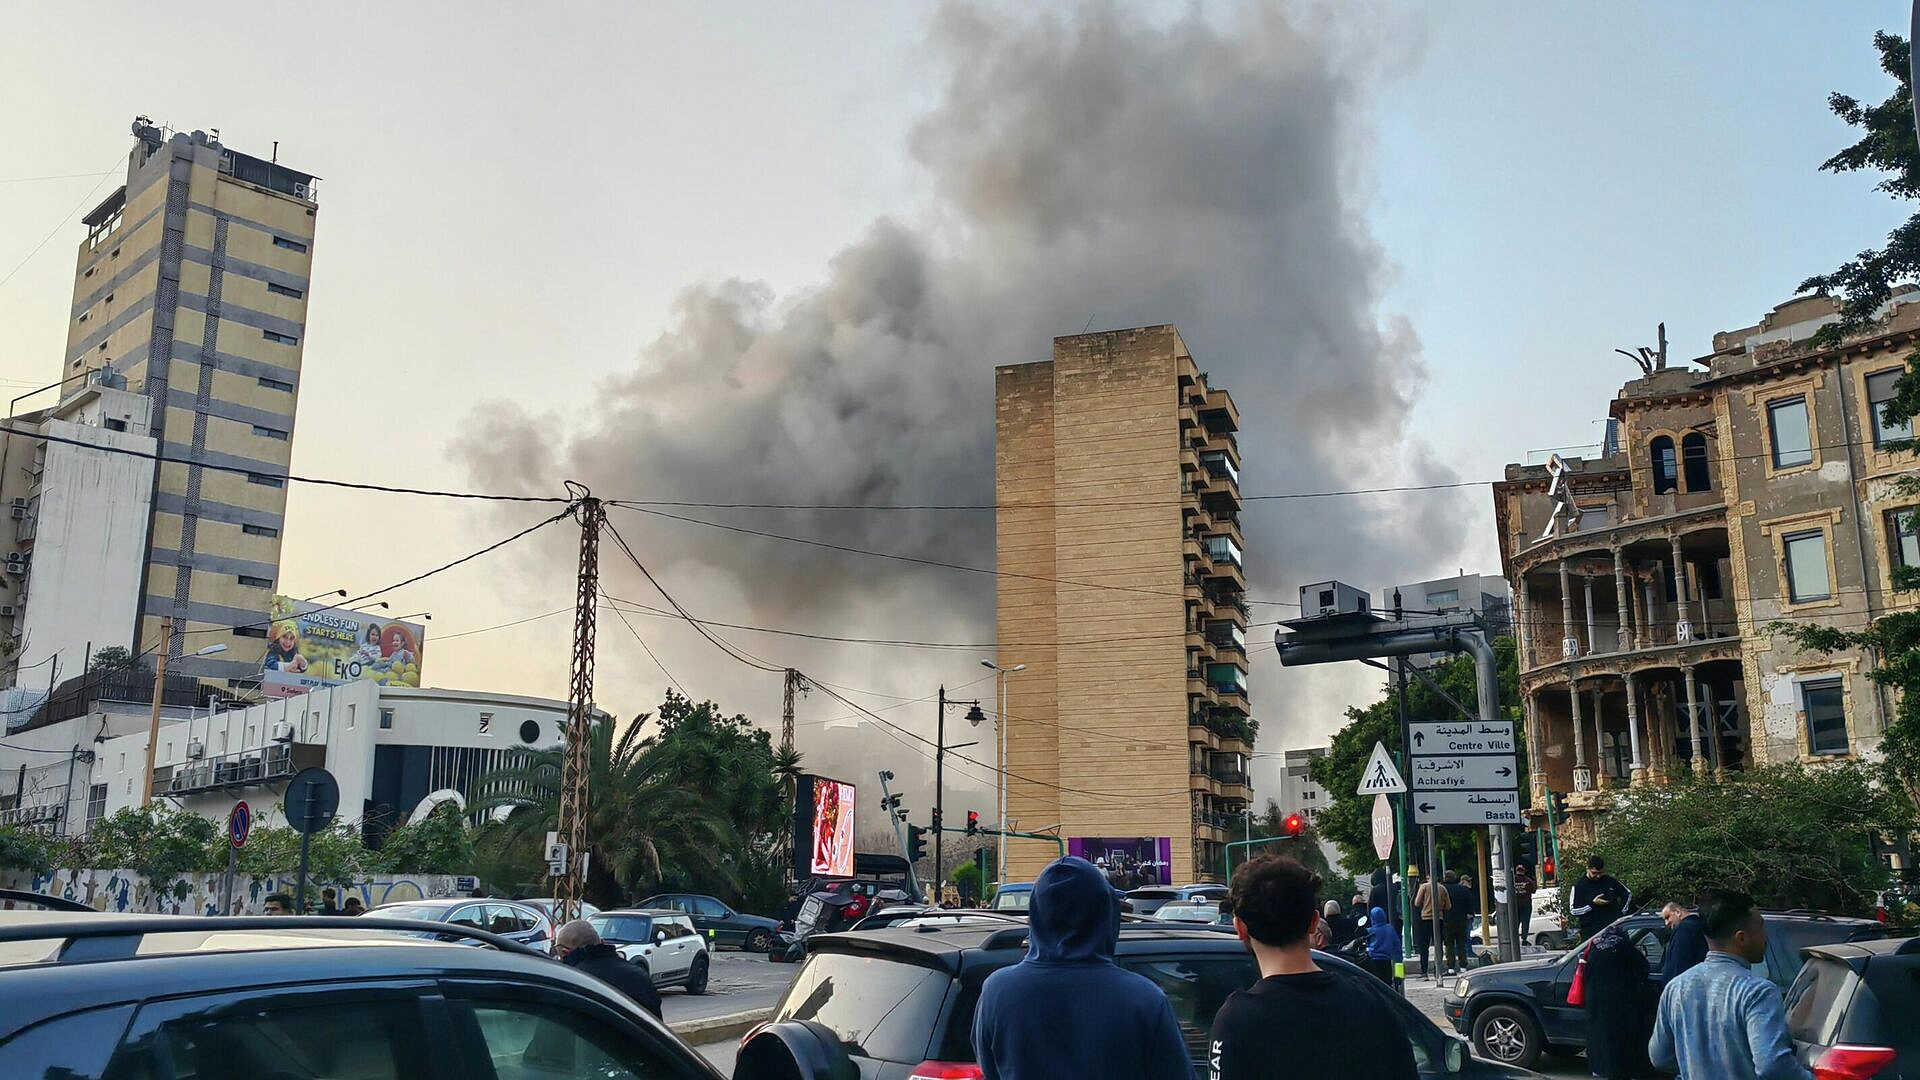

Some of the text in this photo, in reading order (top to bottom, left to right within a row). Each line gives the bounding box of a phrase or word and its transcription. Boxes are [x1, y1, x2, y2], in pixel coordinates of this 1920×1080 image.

[303, 612, 339, 628] ENDLESS
[340, 619, 359, 631] FUN
[306, 626, 336, 639] STARTS
[336, 631, 355, 641] HERE
[334, 658, 362, 680] EKO
[1436, 724, 1510, 737] وسط المدينة
[1449, 741, 1511, 750] Centre Ville
[1418, 776, 1465, 787] Achrafiyé
[1468, 794, 1515, 806] البسطة
[1485, 811, 1516, 820] Basta
[1374, 816, 1391, 838] STOP
